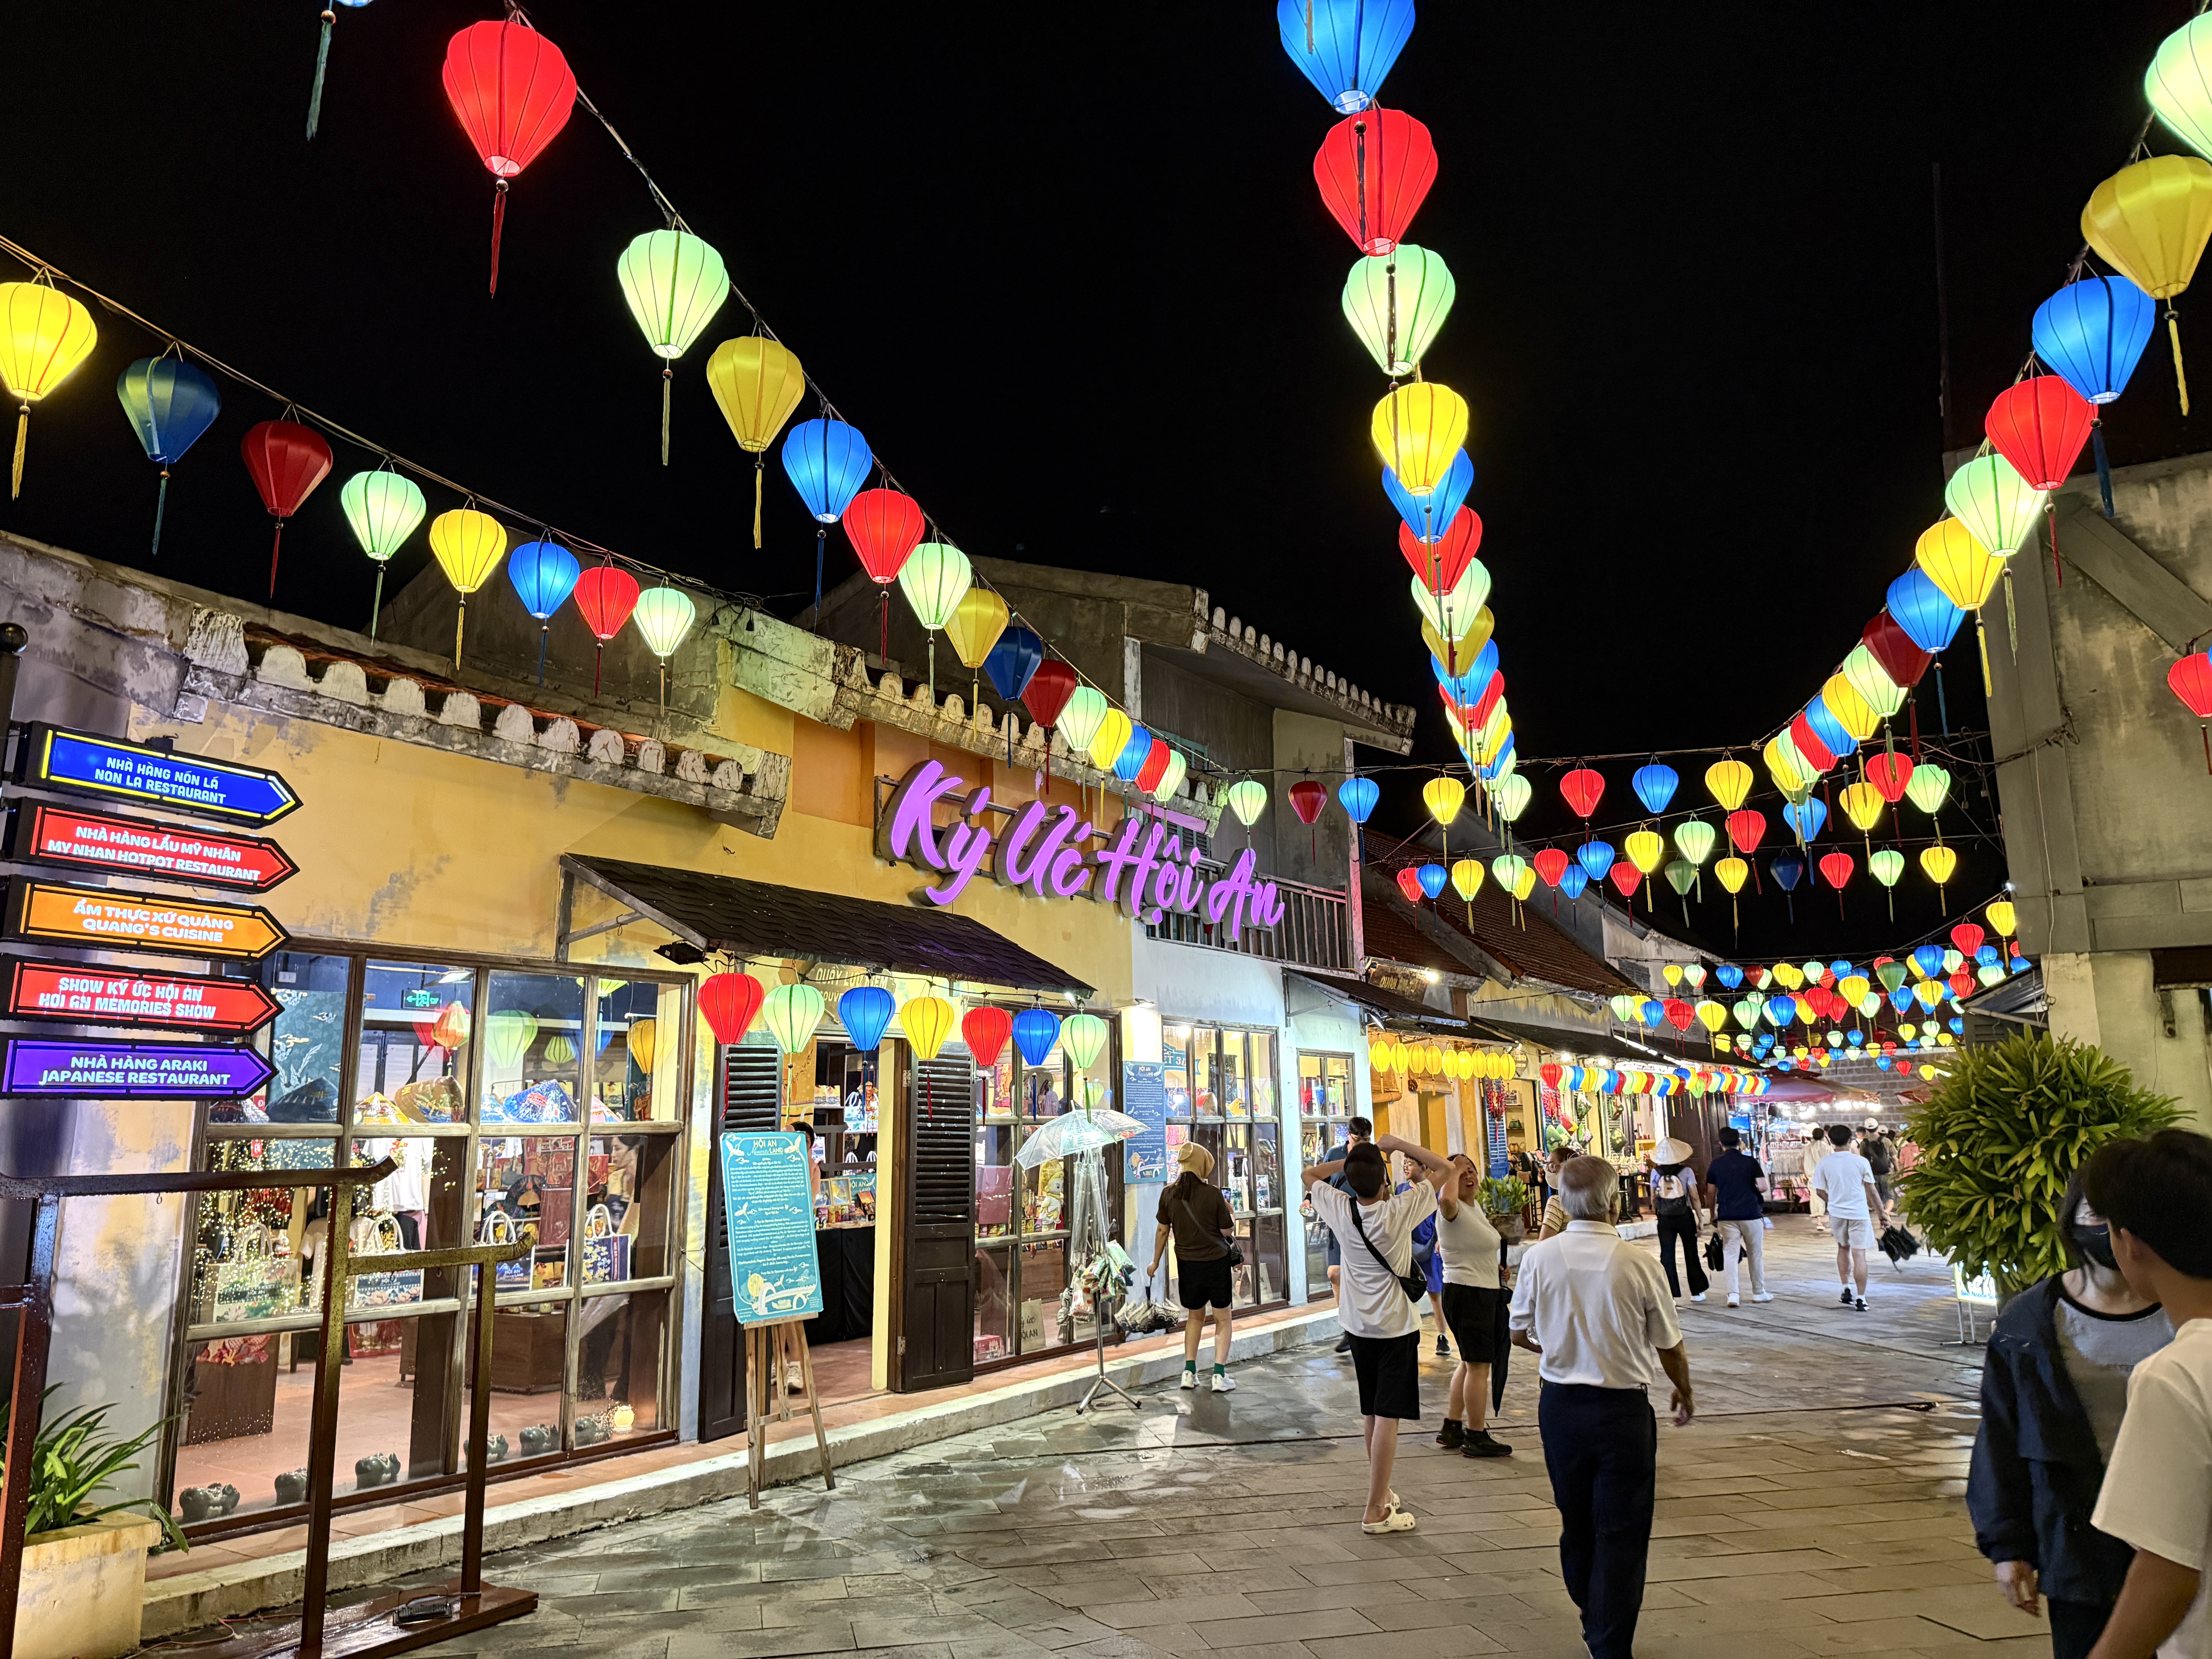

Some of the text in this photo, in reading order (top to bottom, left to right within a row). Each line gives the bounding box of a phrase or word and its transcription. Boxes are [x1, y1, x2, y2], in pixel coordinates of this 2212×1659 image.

[95, 768, 226, 804] NON LA RESTAURANT
[106, 757, 219, 789] NHÀ HÀNG NÓN LÁ
[76, 826, 241, 862] NHÀ HÀNG LẨU MỸ NHÂN
[891, 759, 1285, 941] Ký Ức Hội An
[48, 839, 261, 881] MY NHAN HOTPOT RESTAURANT
[73, 898, 234, 930] ẨM THỰC XỨ QUẢNG
[82, 918, 223, 942] QUANG'S CUISINE
[59, 977, 203, 1003] SHOW KÝ ỨC HỘI AN
[39, 993, 216, 1018] HOI AN MEMORIES SHOW
[70, 1054, 207, 1072] NHÀ HÀNG ARAKI
[39, 1070, 231, 1085] JAPANESE RESTAURANT
[753, 1138, 766, 1149] HỘI
[1029, 1329, 1038, 1338] AN
